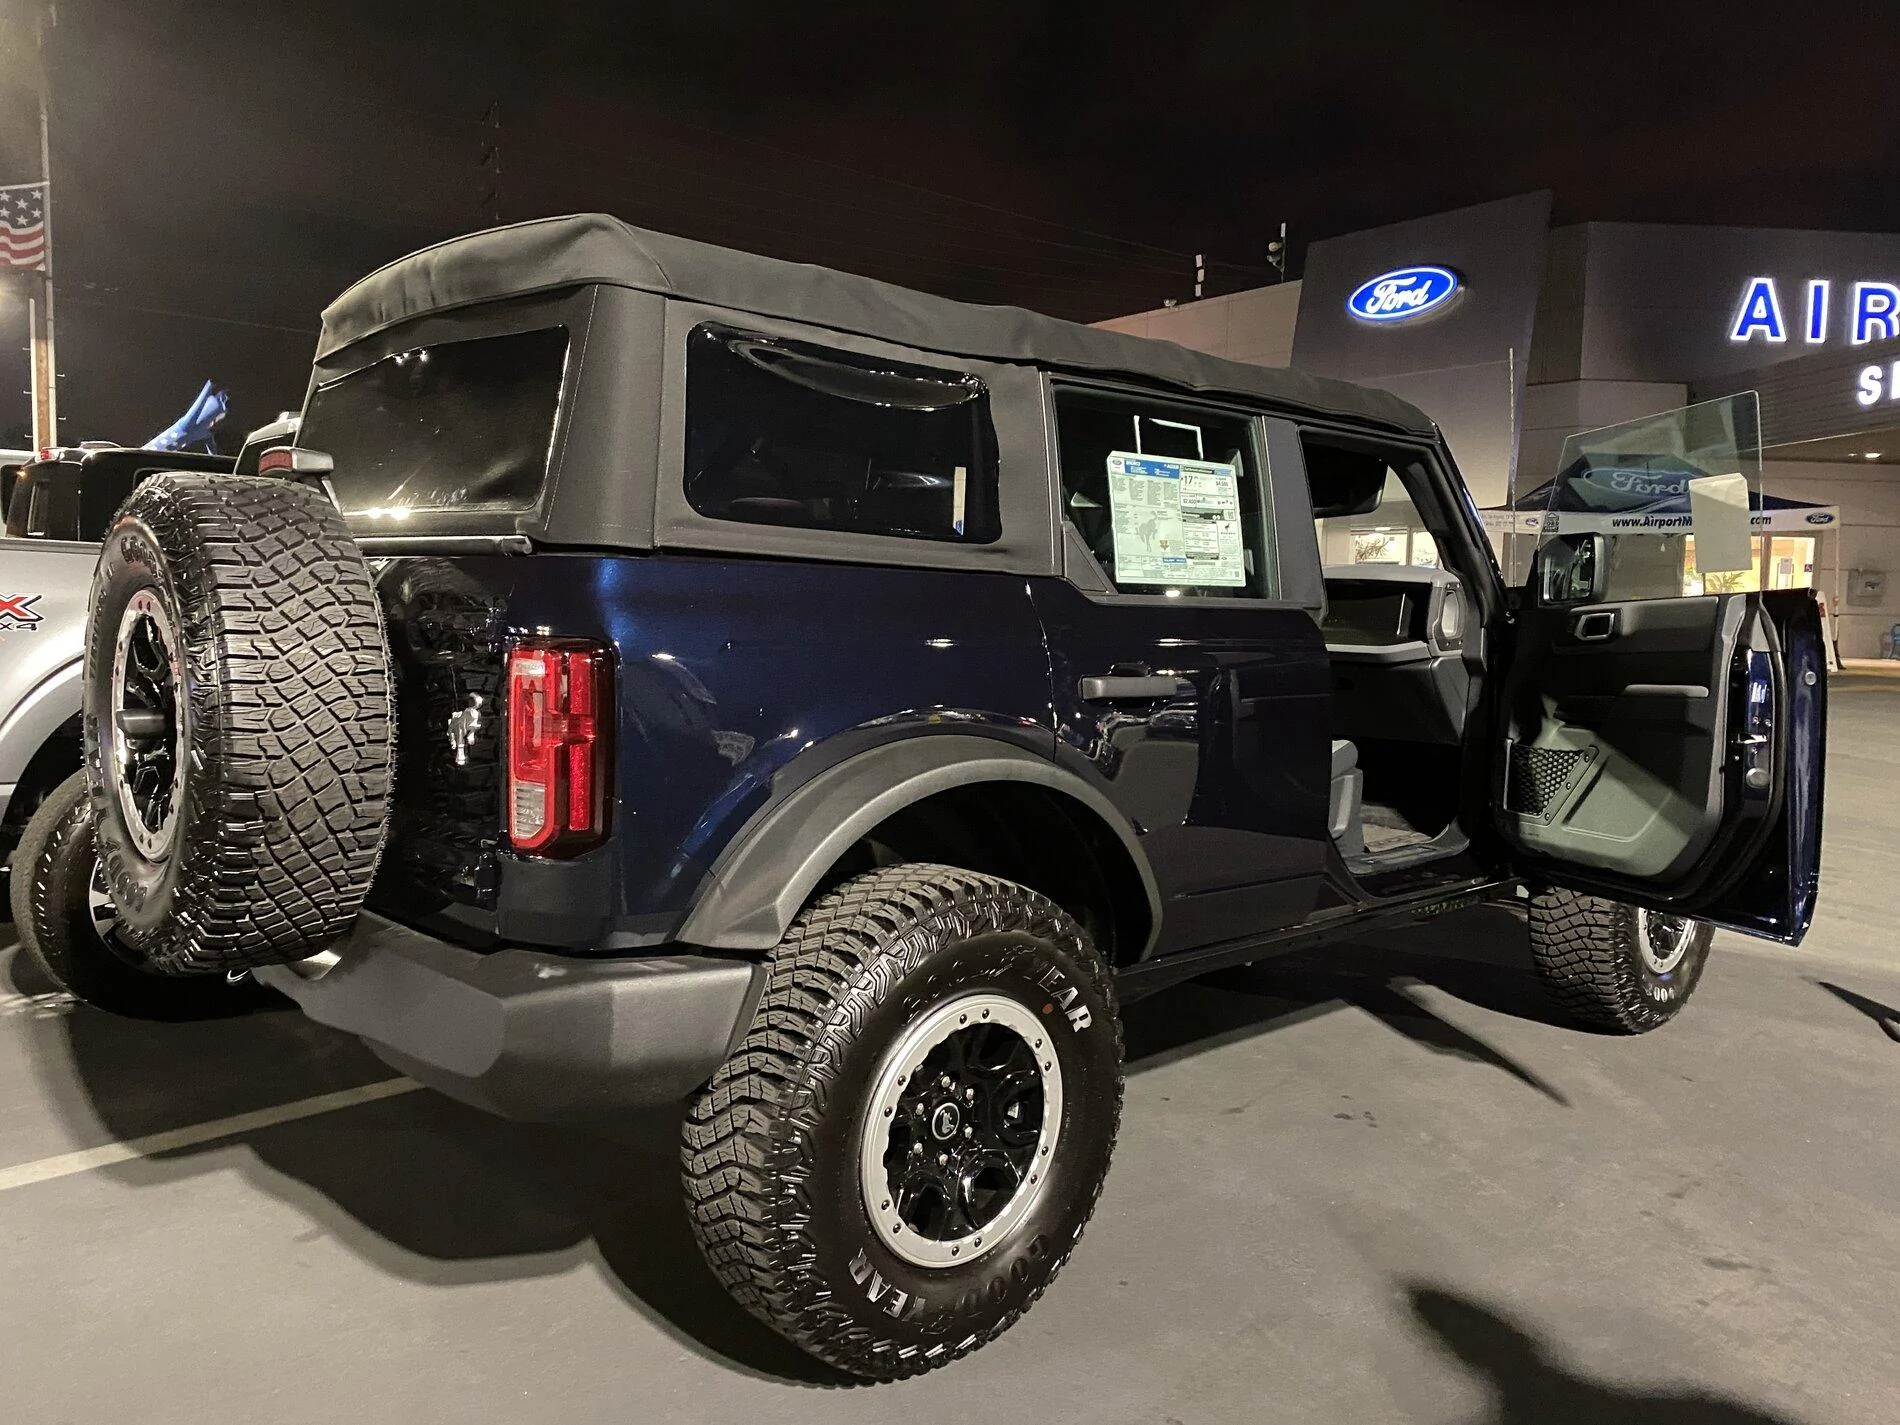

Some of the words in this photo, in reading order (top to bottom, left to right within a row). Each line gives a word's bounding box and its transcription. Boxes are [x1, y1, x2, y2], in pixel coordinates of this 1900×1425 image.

[1365, 276, 1432, 314] Ford
[1730, 277, 1900, 345] AIR
[1610, 471, 1691, 494] Ford
